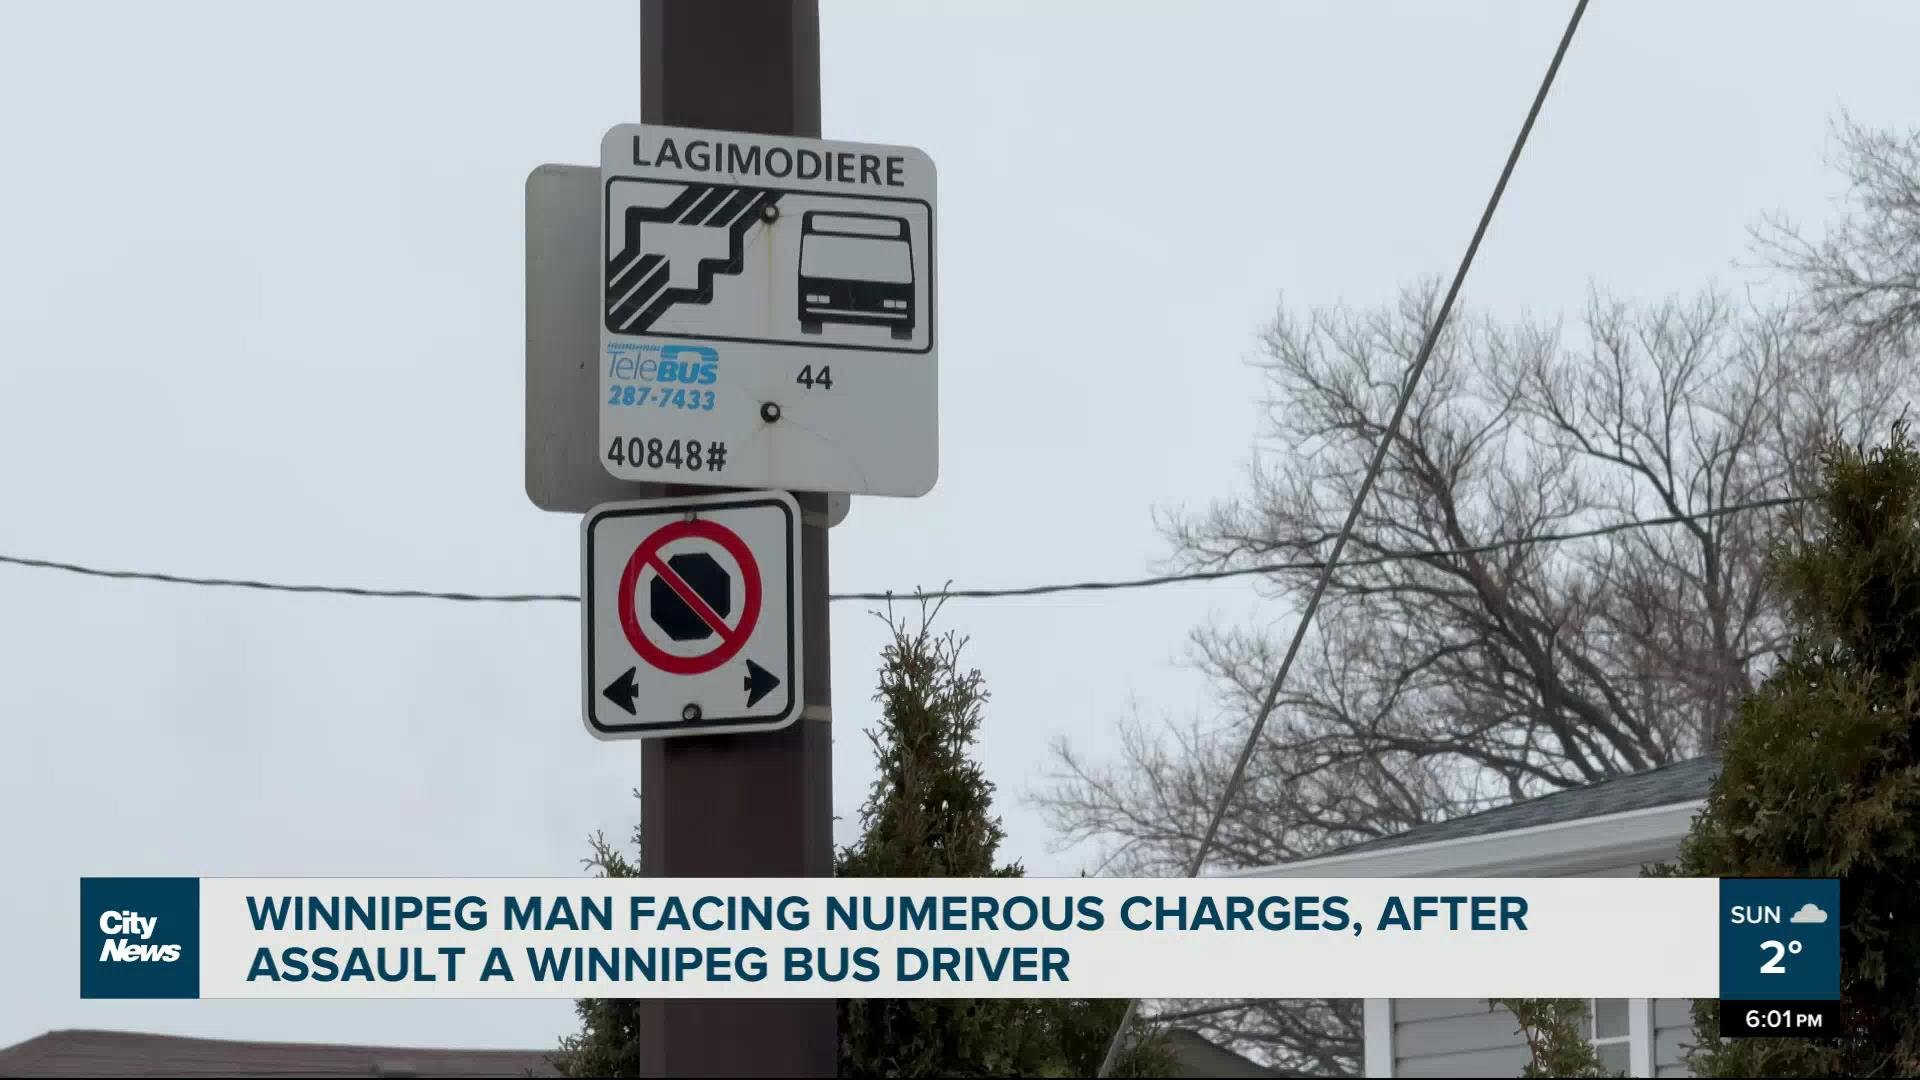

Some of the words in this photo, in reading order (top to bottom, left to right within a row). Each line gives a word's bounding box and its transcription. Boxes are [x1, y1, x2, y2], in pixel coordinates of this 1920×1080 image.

[632, 135, 905, 187] LAGIMODIERE
[607, 350, 718, 385] TeleBUS
[796, 364, 833, 390] 44
[607, 384, 716, 411] 287-7433
[607, 436, 728, 472] 40848#
